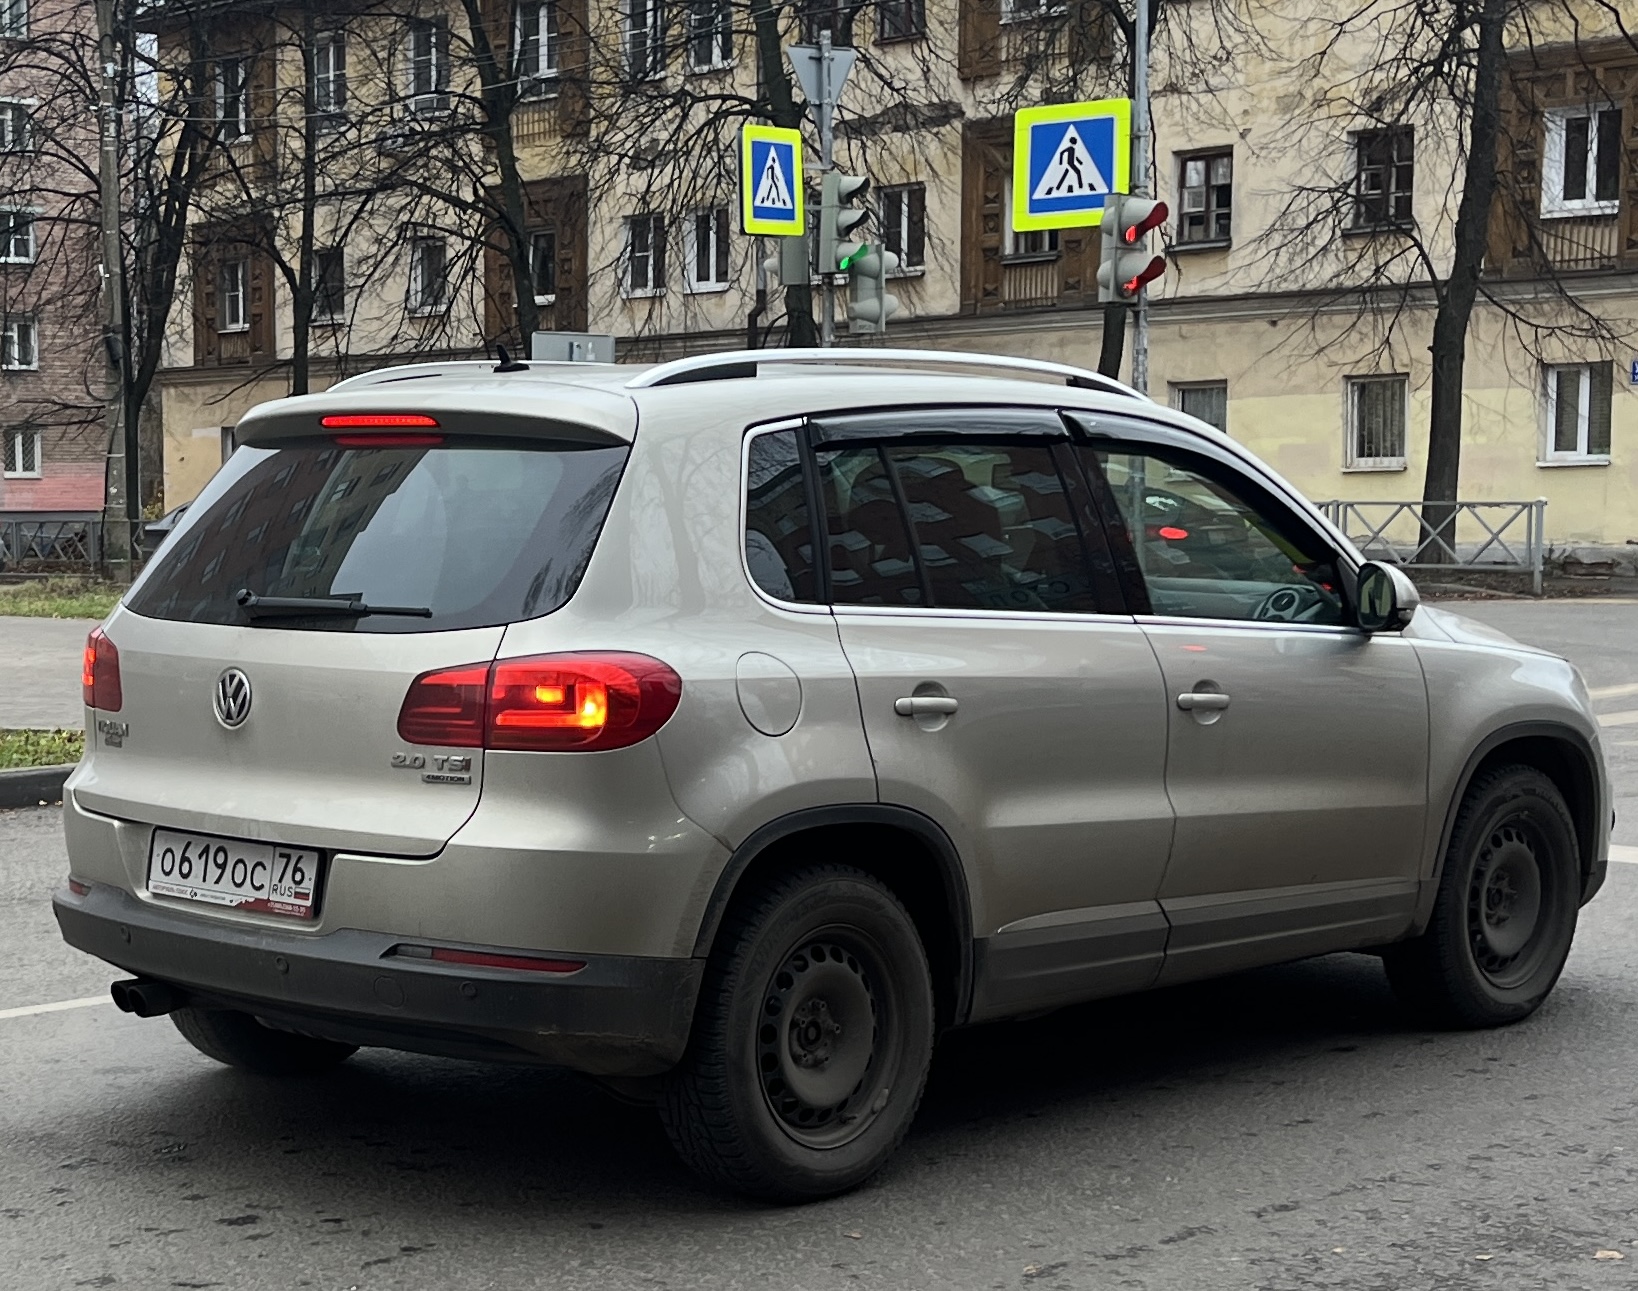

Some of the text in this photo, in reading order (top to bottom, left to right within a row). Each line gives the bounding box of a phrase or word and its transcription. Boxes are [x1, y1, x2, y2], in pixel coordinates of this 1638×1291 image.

[391, 752, 426, 770] 2.0
[277, 852, 306, 886] 76
[271, 883, 293, 898] RUS
